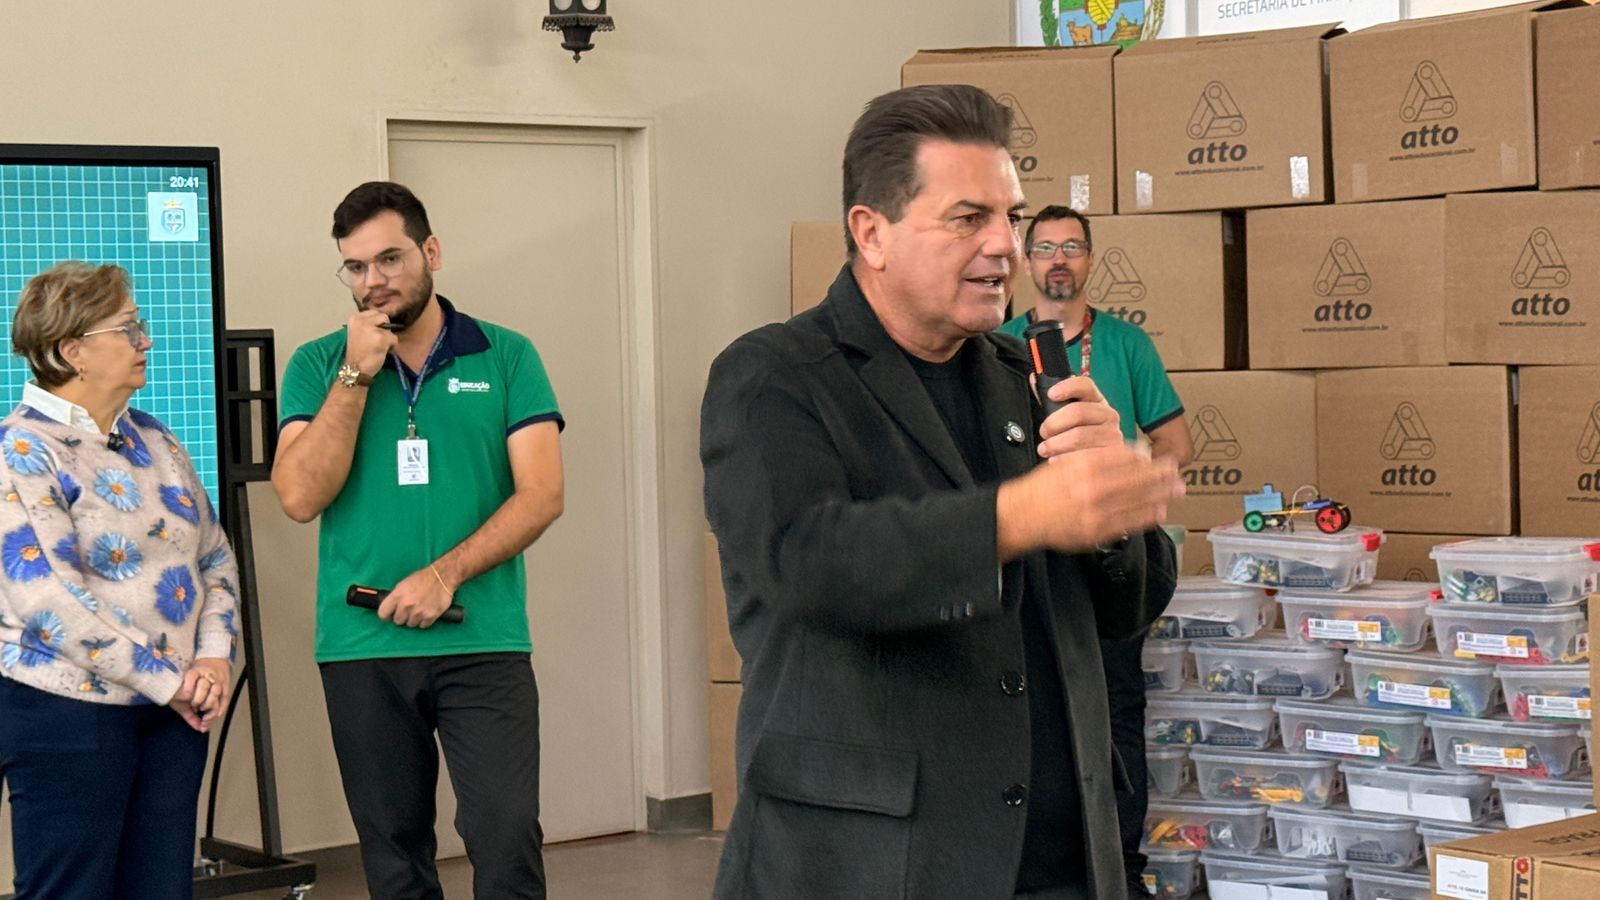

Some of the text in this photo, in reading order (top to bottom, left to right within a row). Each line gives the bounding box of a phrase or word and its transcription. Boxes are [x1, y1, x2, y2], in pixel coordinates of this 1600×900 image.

[1217, 0, 1289, 19] SECRETARIA
[1401, 124, 1459, 149] atto
[1187, 141, 1248, 165] atto
[169, 175, 199, 188] 20:41
[1313, 299, 1373, 322] atto
[1511, 292, 1571, 316] atto
[1182, 464, 1243, 486] atto
[1381, 464, 1437, 486] atto
[1577, 468, 1600, 492] at
[1515, 857, 1530, 900] TTO
